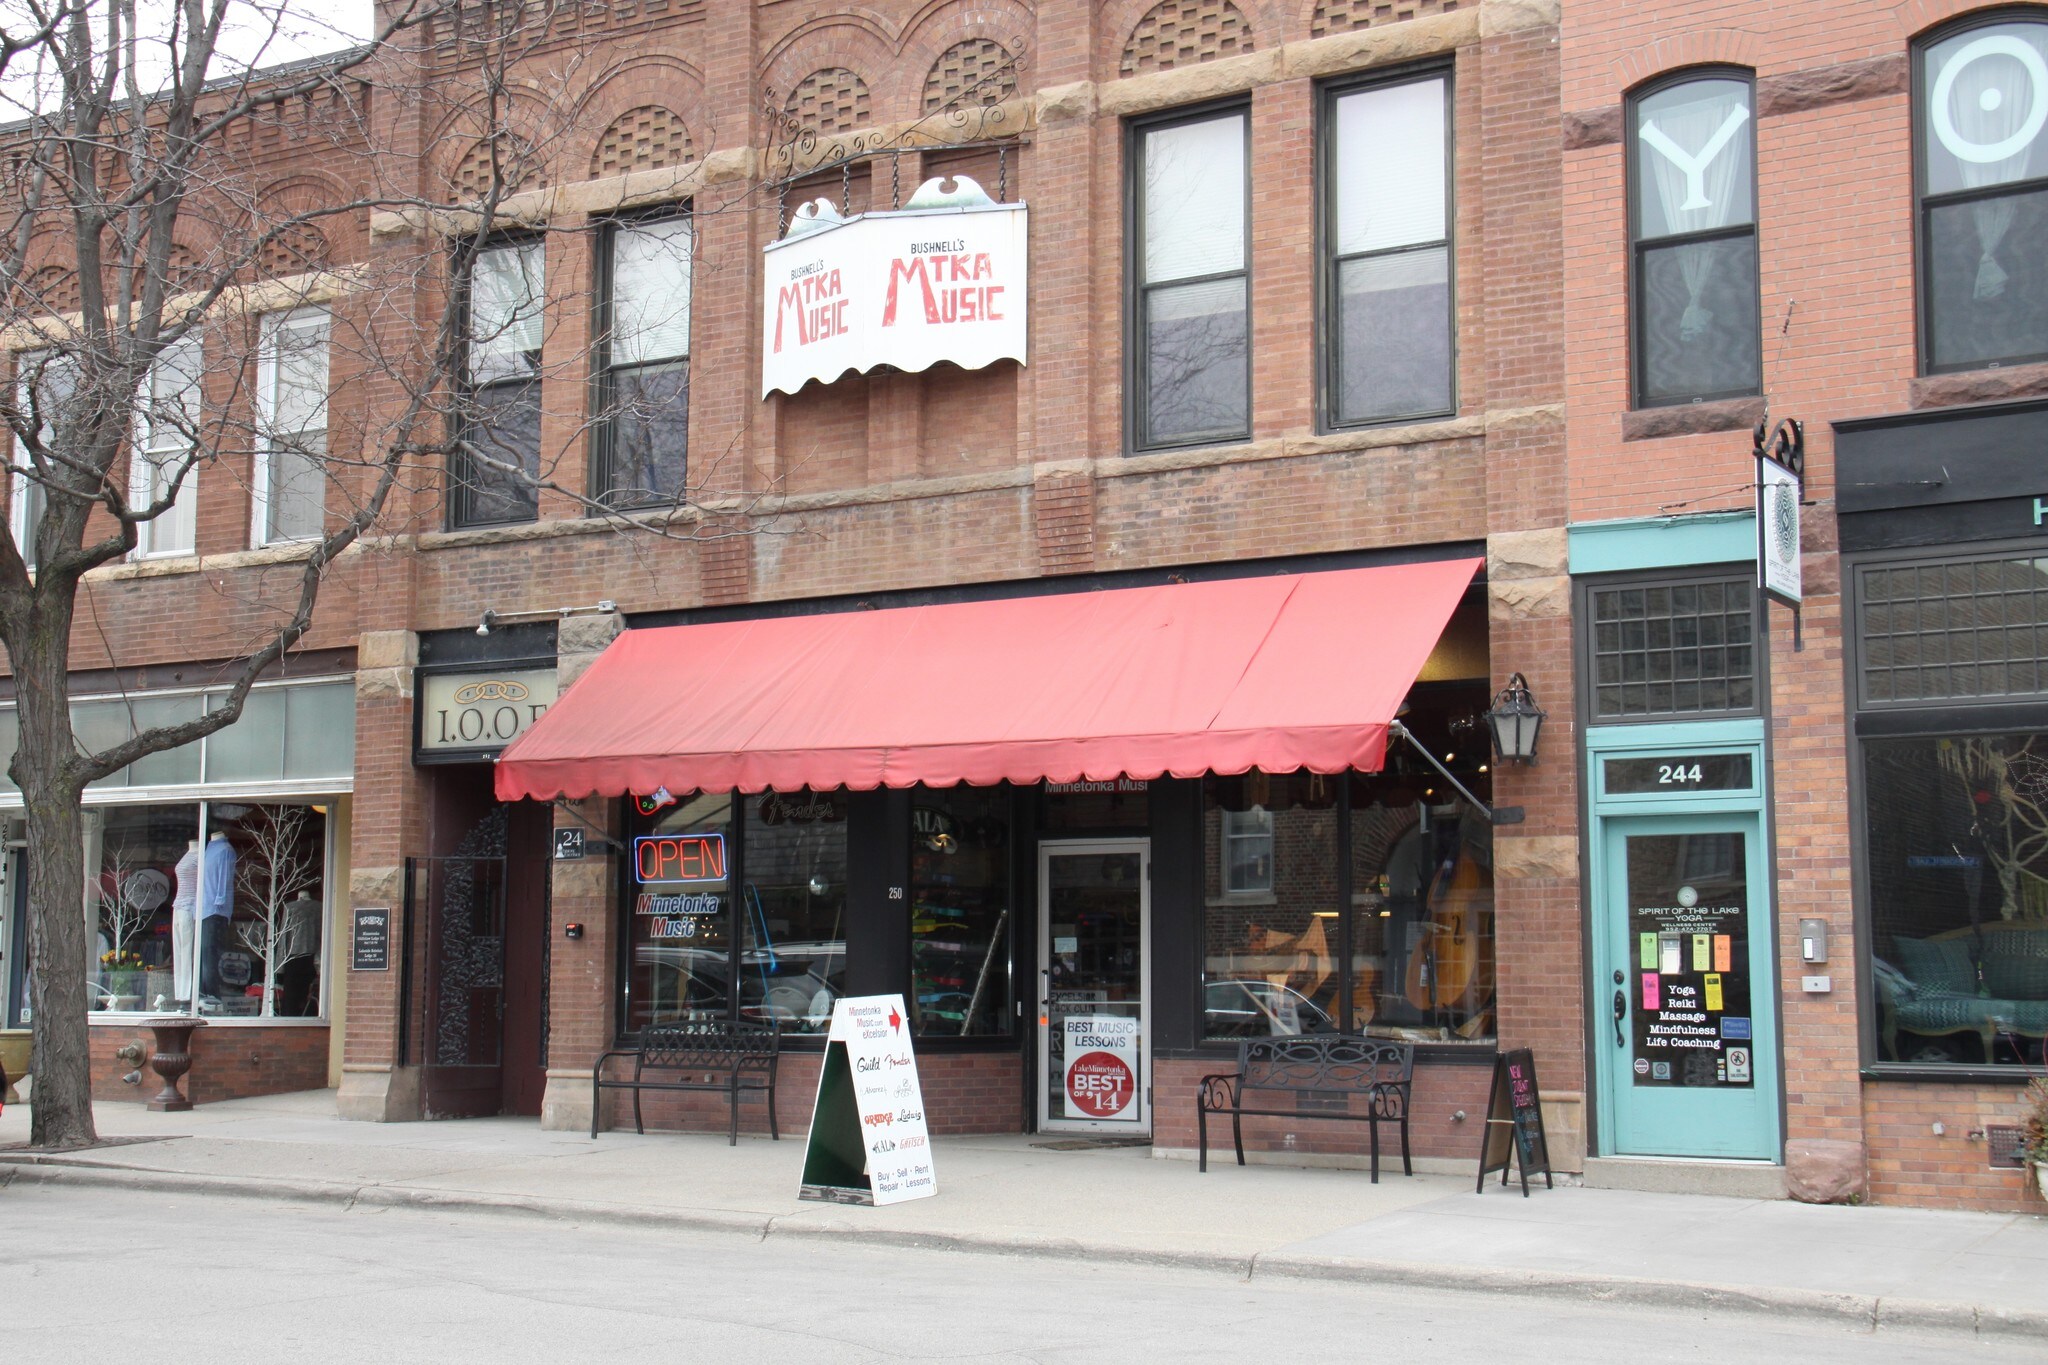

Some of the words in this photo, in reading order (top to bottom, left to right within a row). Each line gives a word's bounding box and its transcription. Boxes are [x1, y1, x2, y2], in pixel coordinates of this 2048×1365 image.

[911, 239, 964, 254] BUSHNELL'S
[791, 259, 824, 280] BUSHNELL'S
[1658, 764, 1703, 784] 244
[1045, 780, 1114, 793] Minnetonka
[562, 831, 582, 847] 24
[638, 838, 723, 879] OPEN
[888, 887, 902, 900] 250
[636, 893, 718, 915] Minnetonka
[1671, 907, 1685, 915] OF
[1675, 914, 1703, 922] YOGA
[650, 917, 695, 938] Music
[1668, 985, 1696, 996] Yoga
[1668, 998, 1696, 1009] Reiki
[849, 1006, 881, 1017] Minnetonka
[1659, 1011, 1706, 1023] Massage
[1067, 1022, 1094, 1033] BEST
[1097, 1022, 1134, 1033] MUSIC
[1649, 1025, 1716, 1035] Mindfulness
[1074, 1036, 1126, 1048] LESSONS
[1646, 1037, 1667, 1046] Life
[1670, 1038, 1721, 1050] Coaching
[856, 1056, 880, 1073] Guild
[1074, 1074, 1126, 1091] BEST
[897, 1109, 921, 1122] Ludwig
[900, 1136, 926, 1150] GRETSCH
[877, 1171, 890, 1181] Buy
[897, 1168, 908, 1178] Sell
[914, 1164, 929, 1175] Rent
[880, 1182, 899, 1194] Repair
[906, 1176, 931, 1188] Lessons
